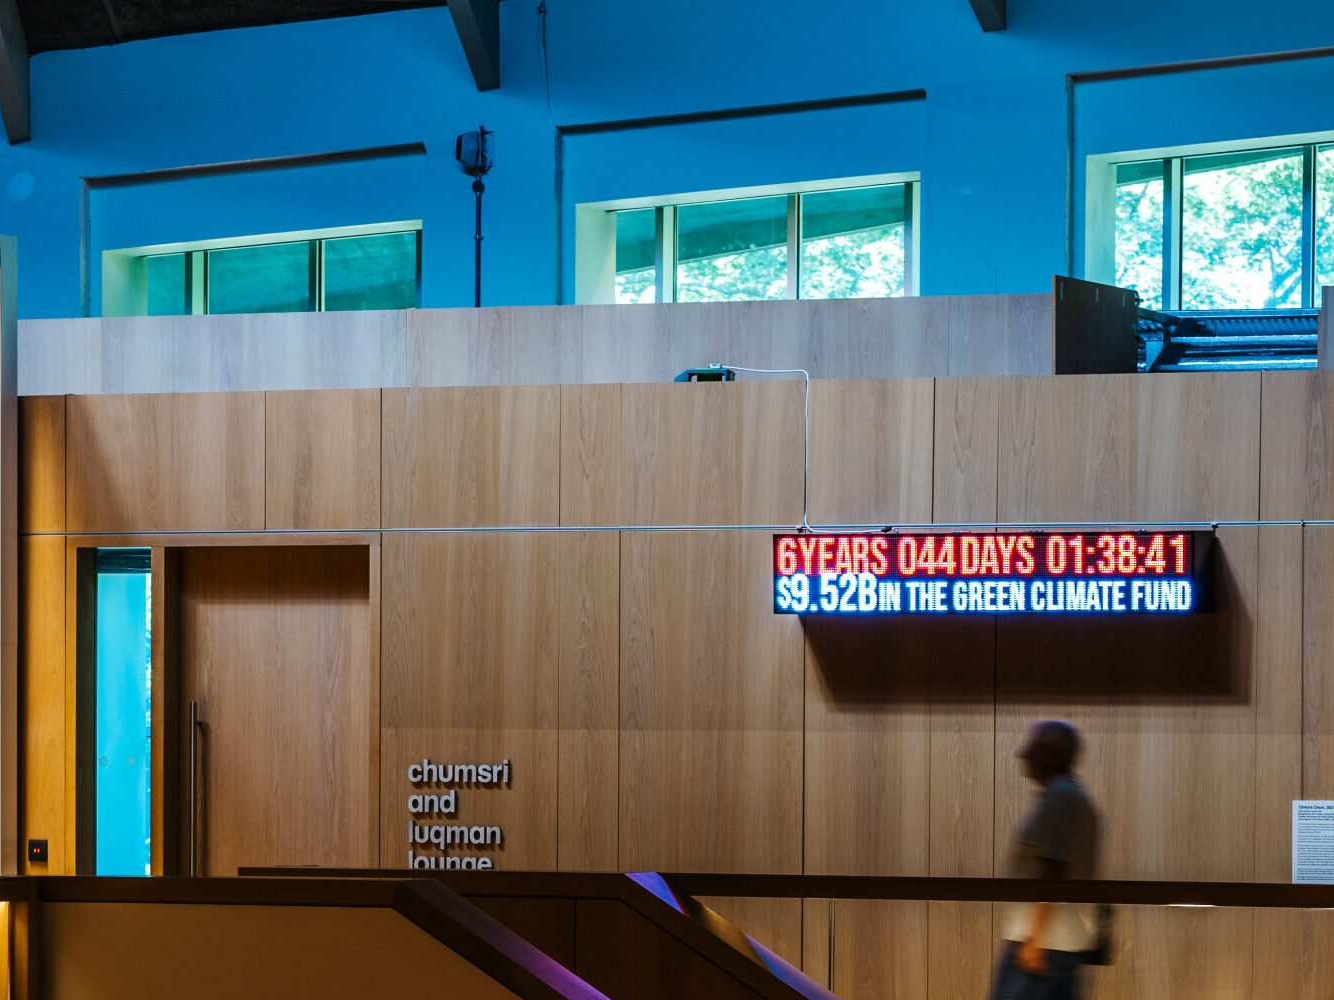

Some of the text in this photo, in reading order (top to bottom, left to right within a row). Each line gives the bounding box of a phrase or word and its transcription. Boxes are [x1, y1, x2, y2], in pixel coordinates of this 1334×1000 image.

[1046, 534, 1185, 574] 01:38:41
[905, 581, 948, 611] THE
[952, 581, 1026, 611] GREEN
[1030, 581, 1127, 611] CLIMATE
[1131, 580, 1192, 611] FUND
[407, 758, 510, 783] chumsri
[407, 789, 456, 813] and
[408, 819, 501, 850] luqman
